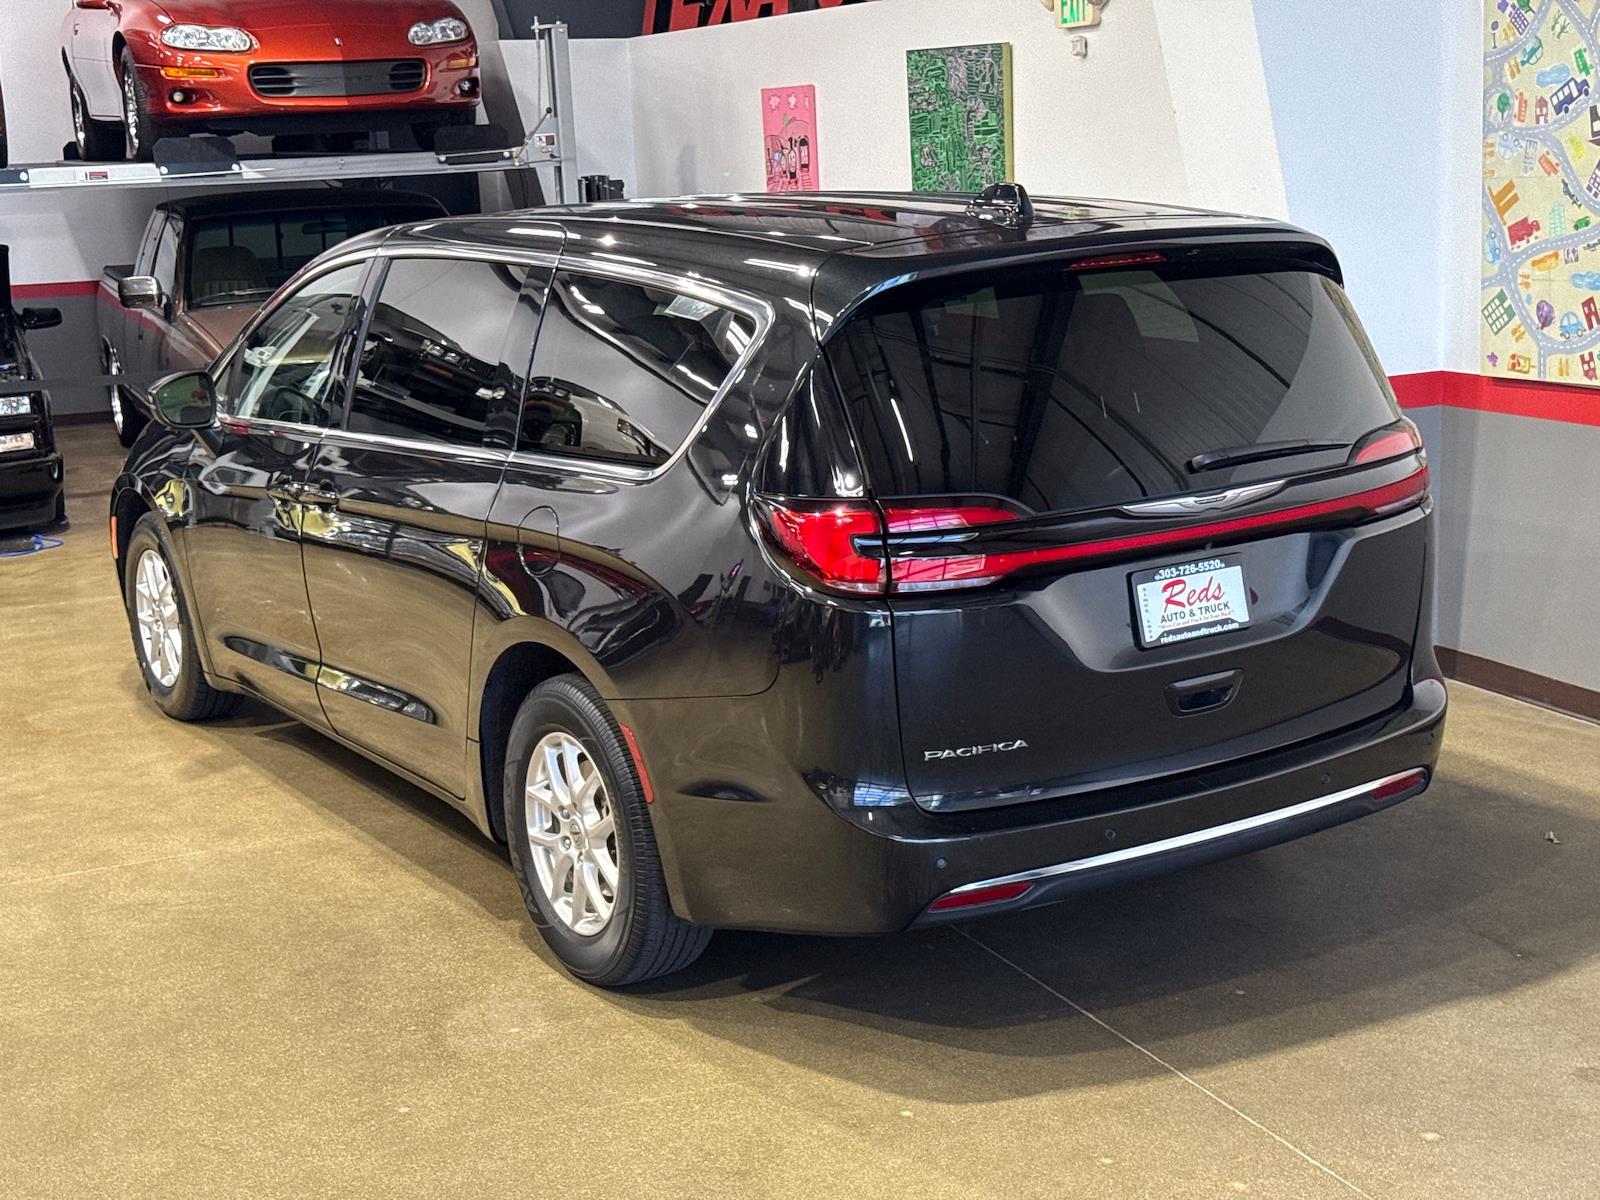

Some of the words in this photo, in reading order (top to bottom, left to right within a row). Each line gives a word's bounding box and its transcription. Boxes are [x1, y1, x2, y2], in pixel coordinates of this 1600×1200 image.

[1159, 559, 1221, 580] 303-726-5520
[1161, 576, 1225, 613] Reds
[1160, 609, 1186, 624] AUTO
[1188, 608, 1196, 617] &
[1199, 601, 1231, 616] TRUCK
[923, 739, 1029, 762] PACIFICA
